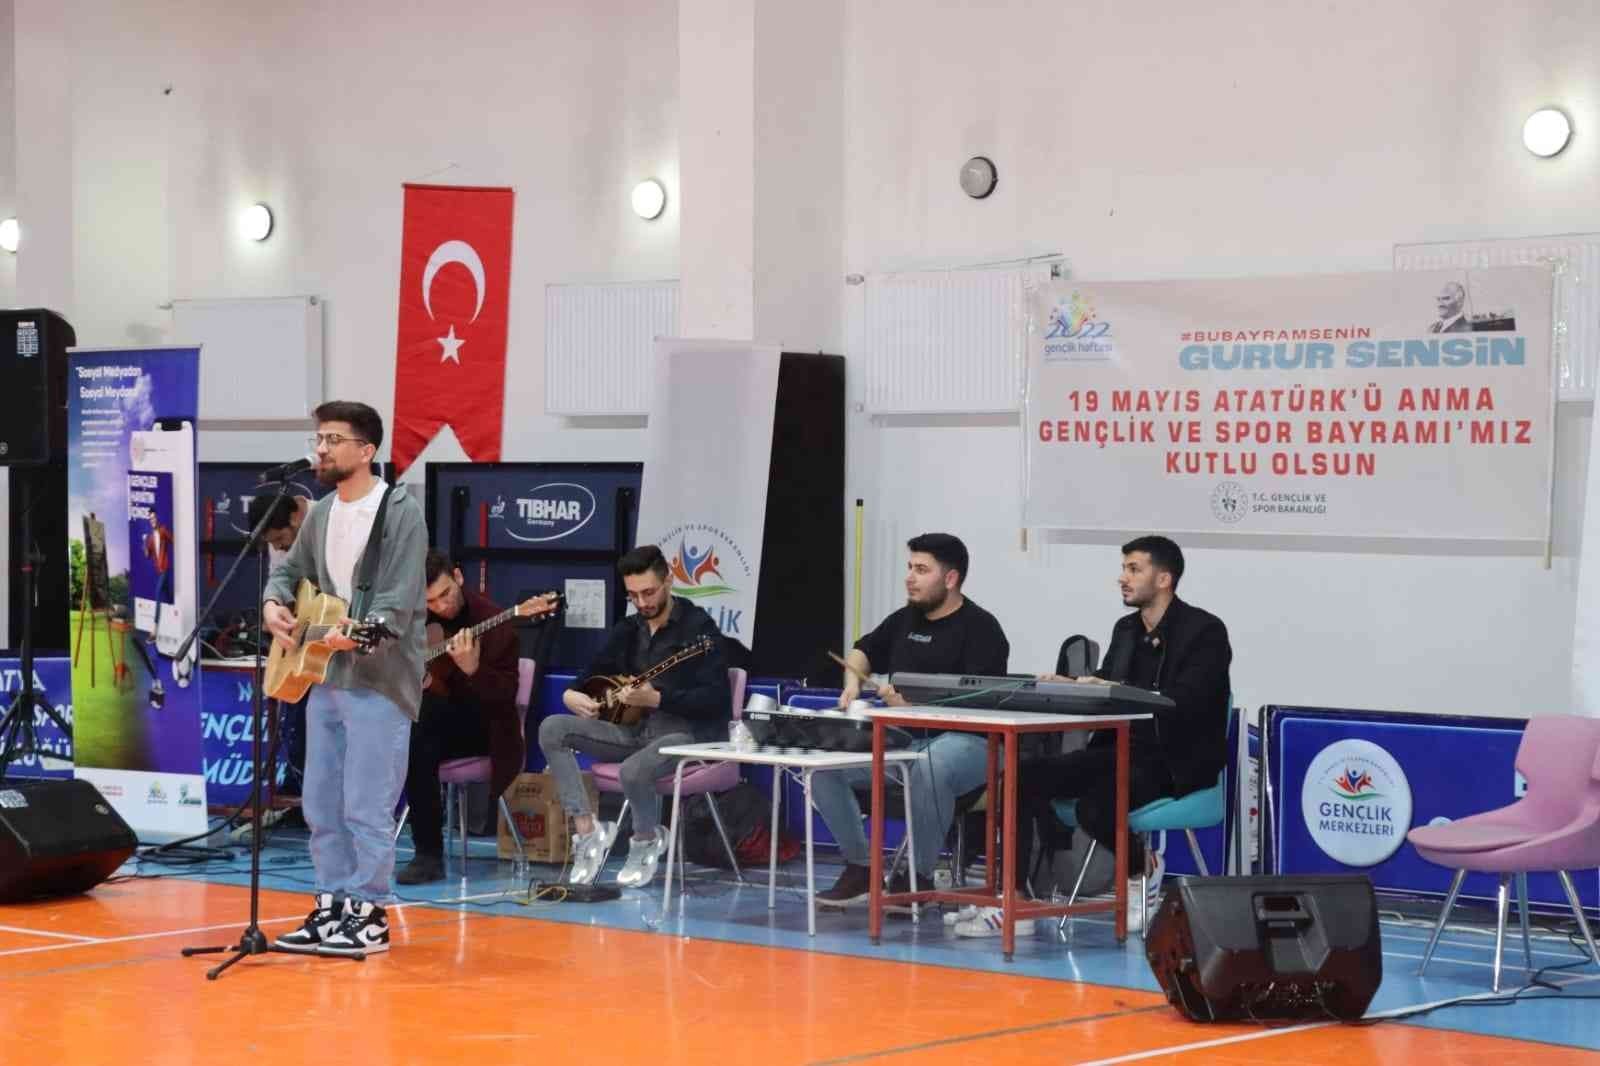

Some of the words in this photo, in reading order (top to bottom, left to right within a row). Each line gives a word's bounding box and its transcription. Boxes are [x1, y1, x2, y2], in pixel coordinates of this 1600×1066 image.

[1180, 325, 1371, 342] #BUBAYRAMSENİN
[1179, 342, 1334, 370] GURUR
[1069, 390, 1099, 412] 19
[1112, 390, 1200, 412] MAYIS
[1214, 384, 1382, 412] ATATÜRK'Ü
[1398, 387, 1495, 411] ANMA
[1039, 416, 1155, 448] GENÇLİK
[1168, 421, 1202, 443] VE
[1216, 421, 1292, 444] SPOR
[1308, 420, 1532, 444] BAYRAMI'MIZ
[1166, 452, 1257, 475] KUTLU
[1272, 452, 1375, 476] OLSUN
[1271, 492, 1311, 503] GENÇLİK
[1314, 493, 1327, 502] VE
[516, 498, 581, 520] TIBHAR
[1252, 504, 1276, 513] SPOR
[1319, 802, 1392, 822] GENÇLİK
[1319, 820, 1394, 836] MERKEZLERİ
